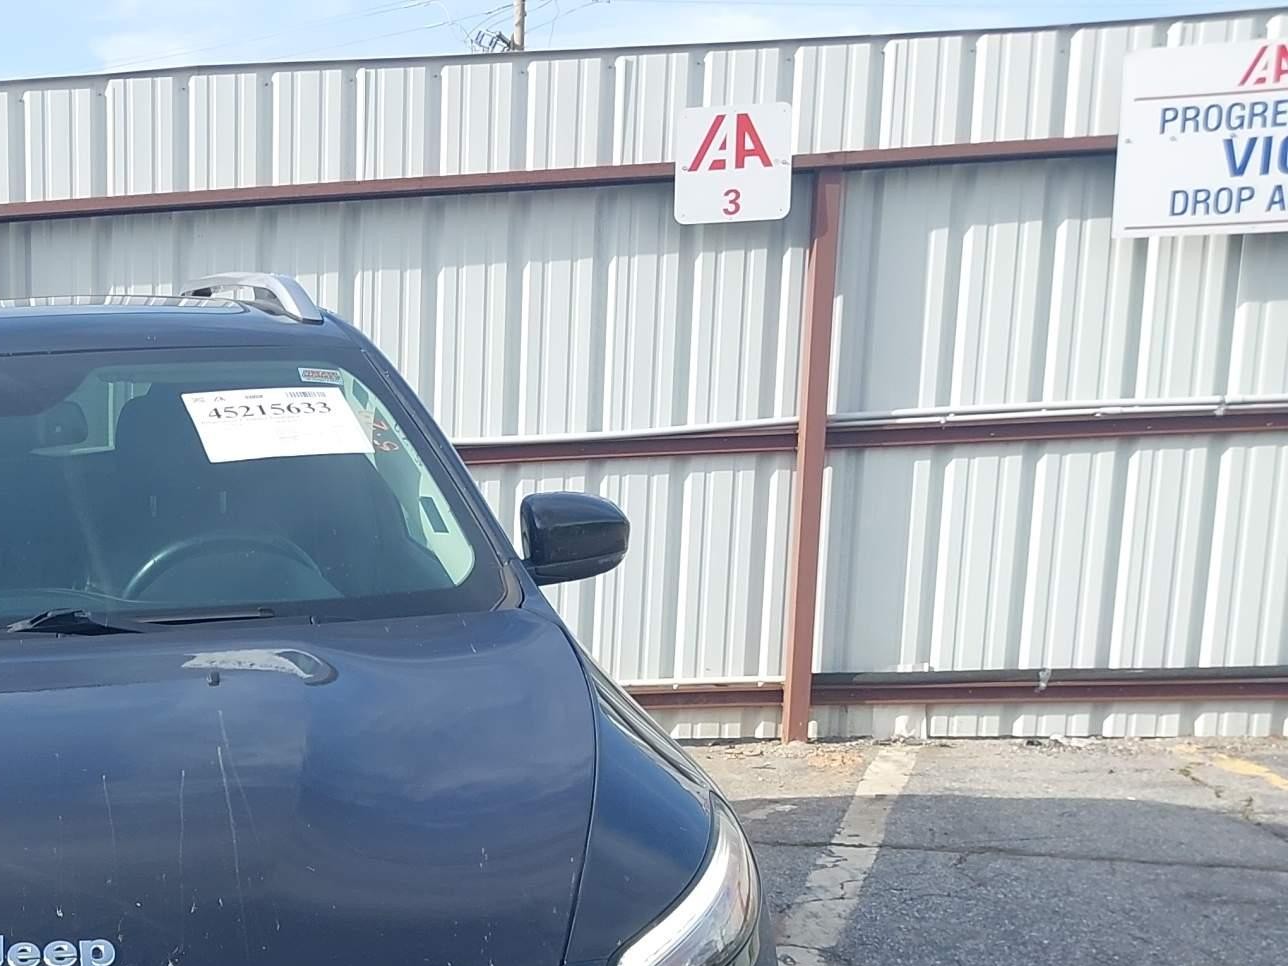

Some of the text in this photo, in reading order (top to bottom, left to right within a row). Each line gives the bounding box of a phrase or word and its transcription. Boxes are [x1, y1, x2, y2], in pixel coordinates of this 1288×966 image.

[722, 189, 741, 216] 3
[1169, 186, 1255, 217] DROP
[208, 401, 332, 419] 45215633
